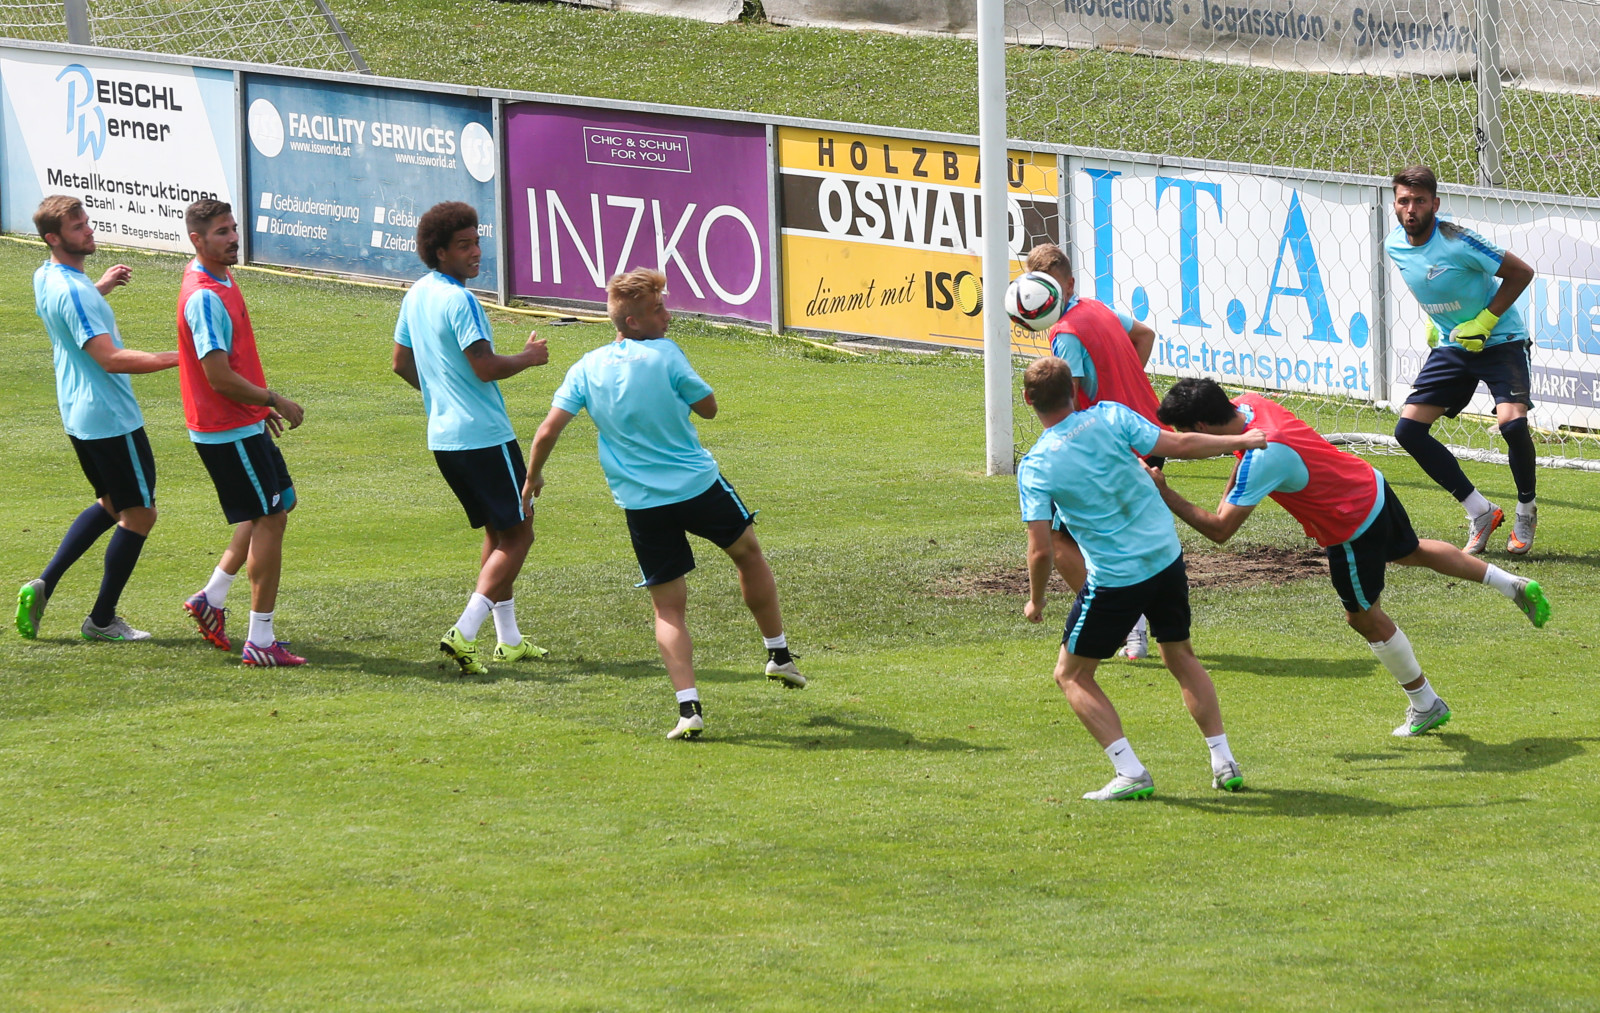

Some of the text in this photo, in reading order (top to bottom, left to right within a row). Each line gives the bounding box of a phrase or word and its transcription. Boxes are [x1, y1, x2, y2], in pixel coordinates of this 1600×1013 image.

[288, 112, 366, 144] FACILITY
[371, 122, 456, 155] SERVICES
[591, 134, 622, 146] CHIC
[639, 139, 682, 152] SCHUH
[290, 141, 352, 157] www.issworld.at
[611, 148, 666, 162] FOR YOU
[395, 153, 457, 170] www.issworld.at
[818, 137, 1025, 188] HOLZBU
[47, 167, 218, 202] Metallkonstruktionen
[85, 195, 116, 211] Stahl
[127, 200, 147, 215] Alu
[158, 204, 184, 219] Niro
[273, 194, 360, 223] Gebäudereinigung
[92, 220, 181, 242] 7551 Stegersbach
[270, 215, 328, 240] Bürodienste
[384, 233, 417, 253] Zeitarb
[526, 187, 762, 305] INZKO
[806, 277, 876, 317] dämmt
[880, 273, 916, 306] mit
